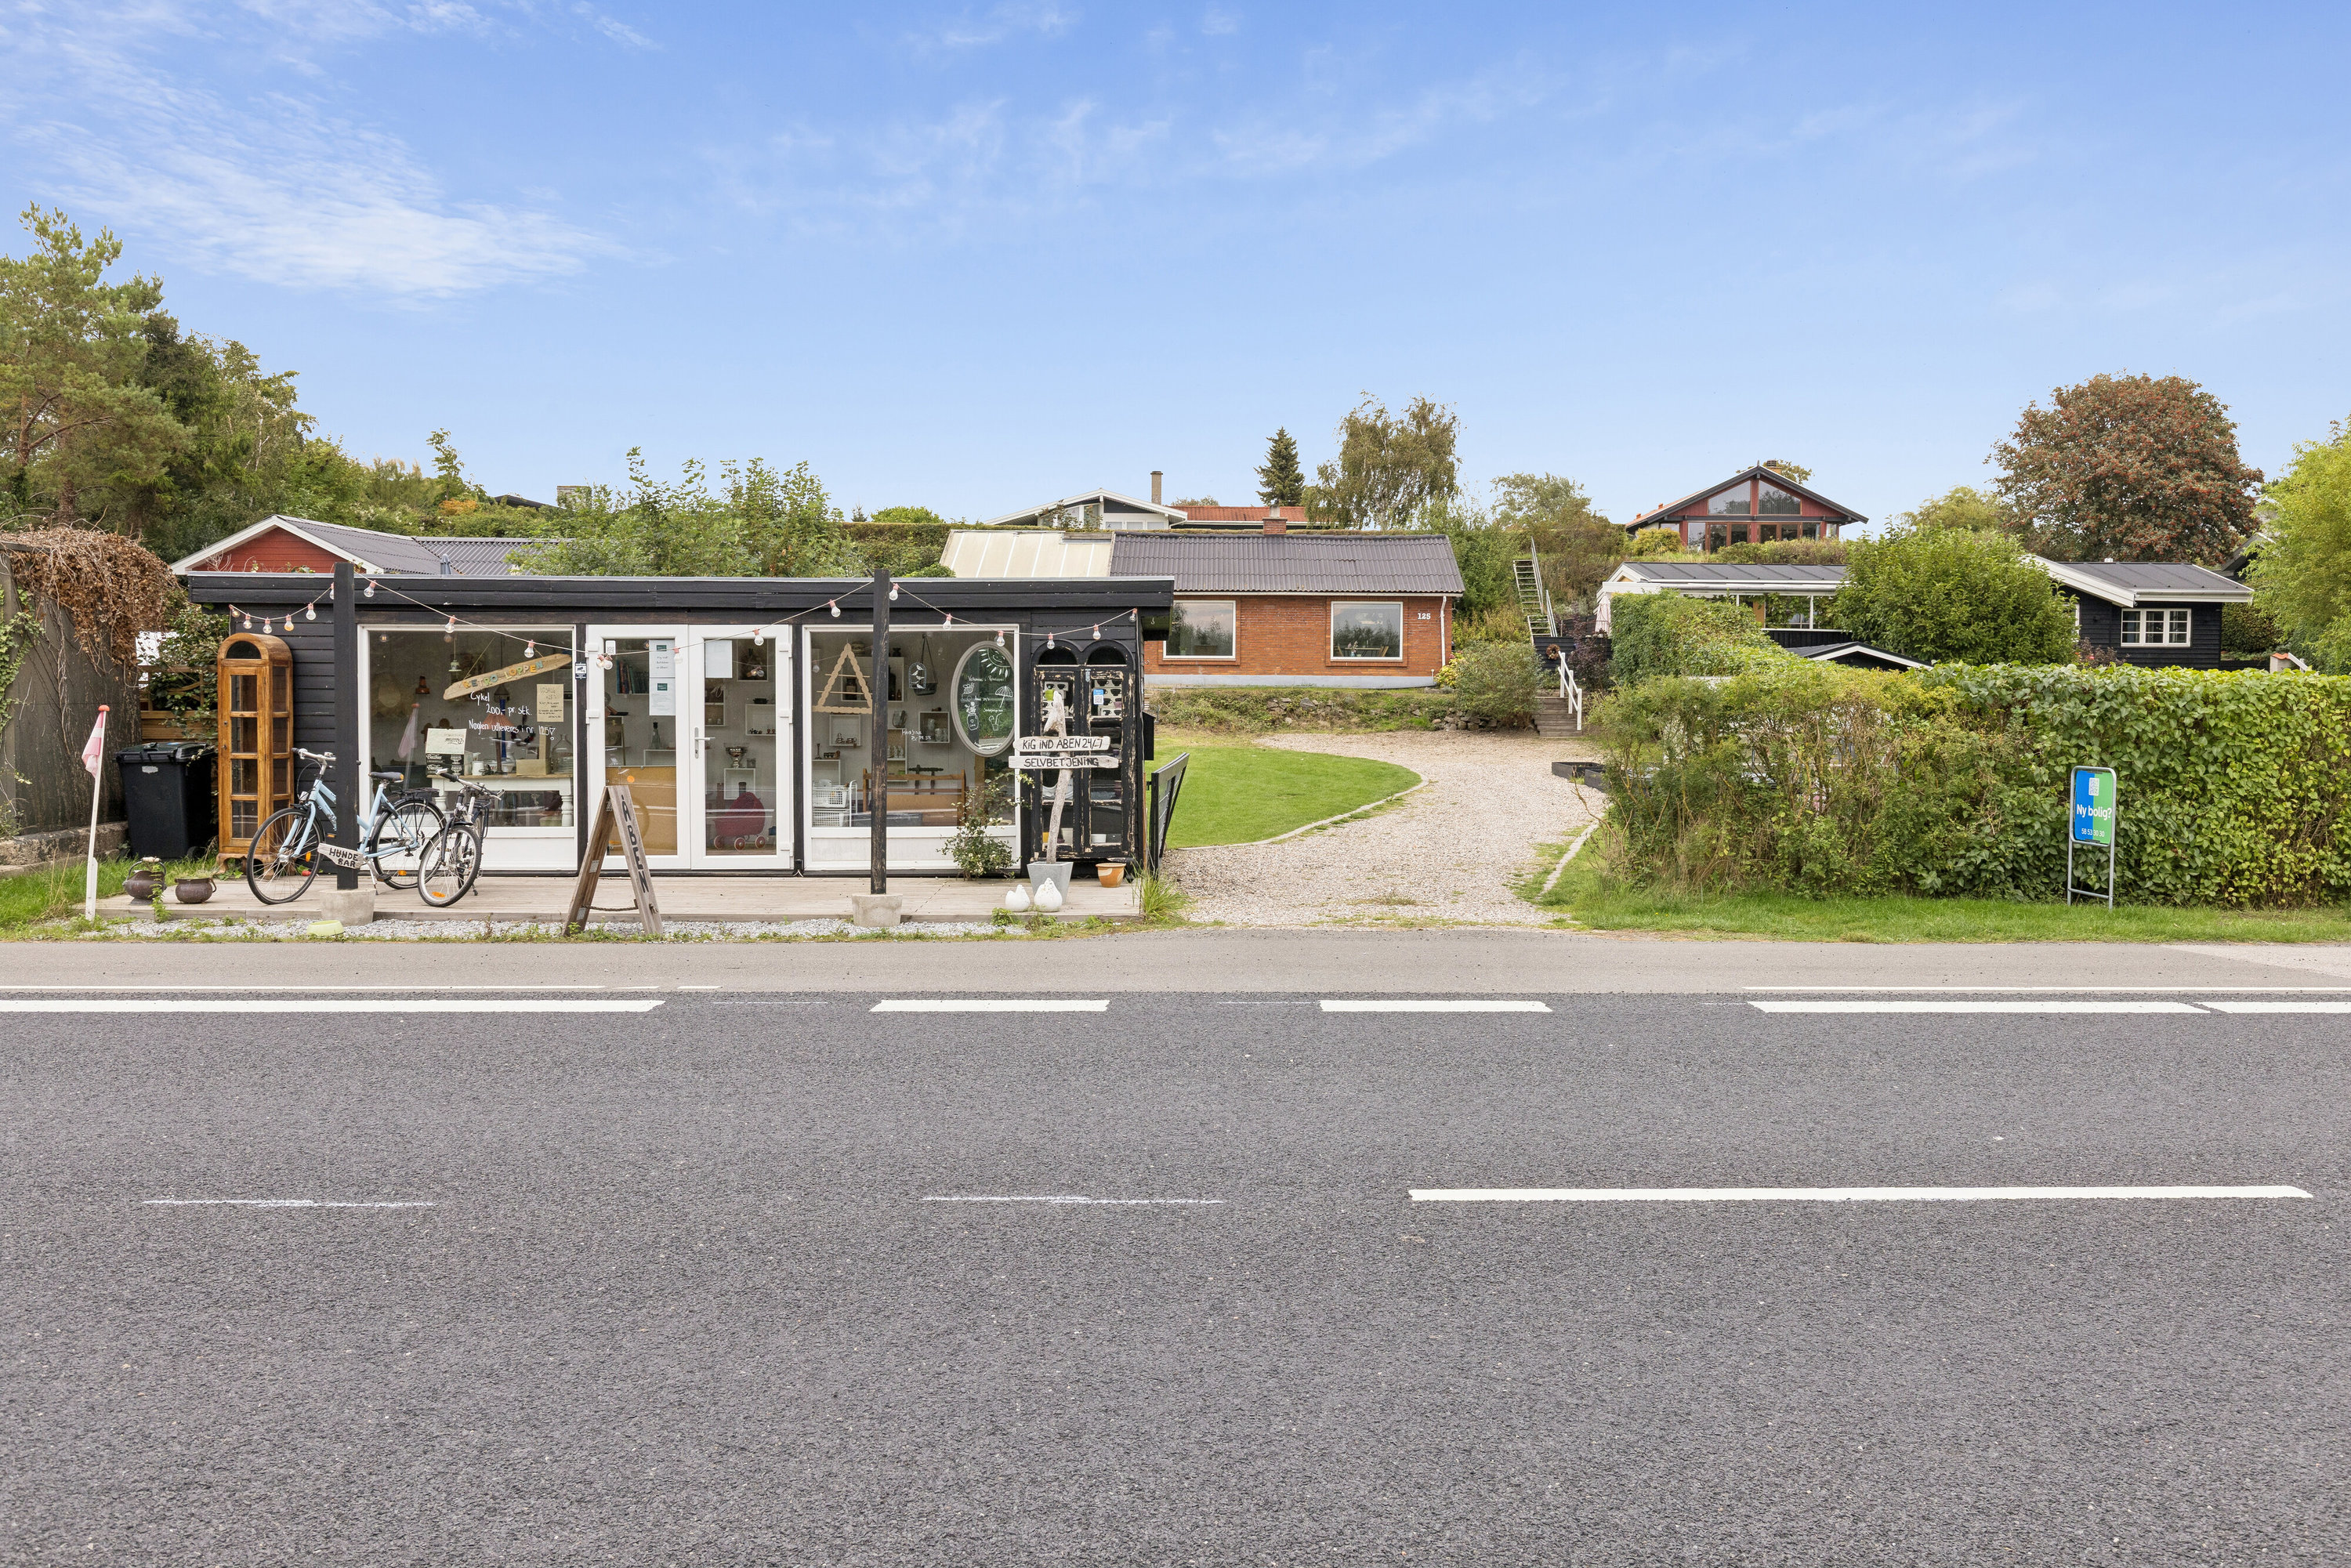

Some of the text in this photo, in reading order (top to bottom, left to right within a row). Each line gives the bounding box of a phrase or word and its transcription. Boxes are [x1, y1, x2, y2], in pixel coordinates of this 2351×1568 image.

[462, 660, 544, 689] RETRO LOPPEN
[470, 690, 490, 706] Cykel
[2076, 803, 2112, 820] Ny bolig?
[329, 848, 358, 861] HUNDE
[338, 858, 356, 867] BAR
